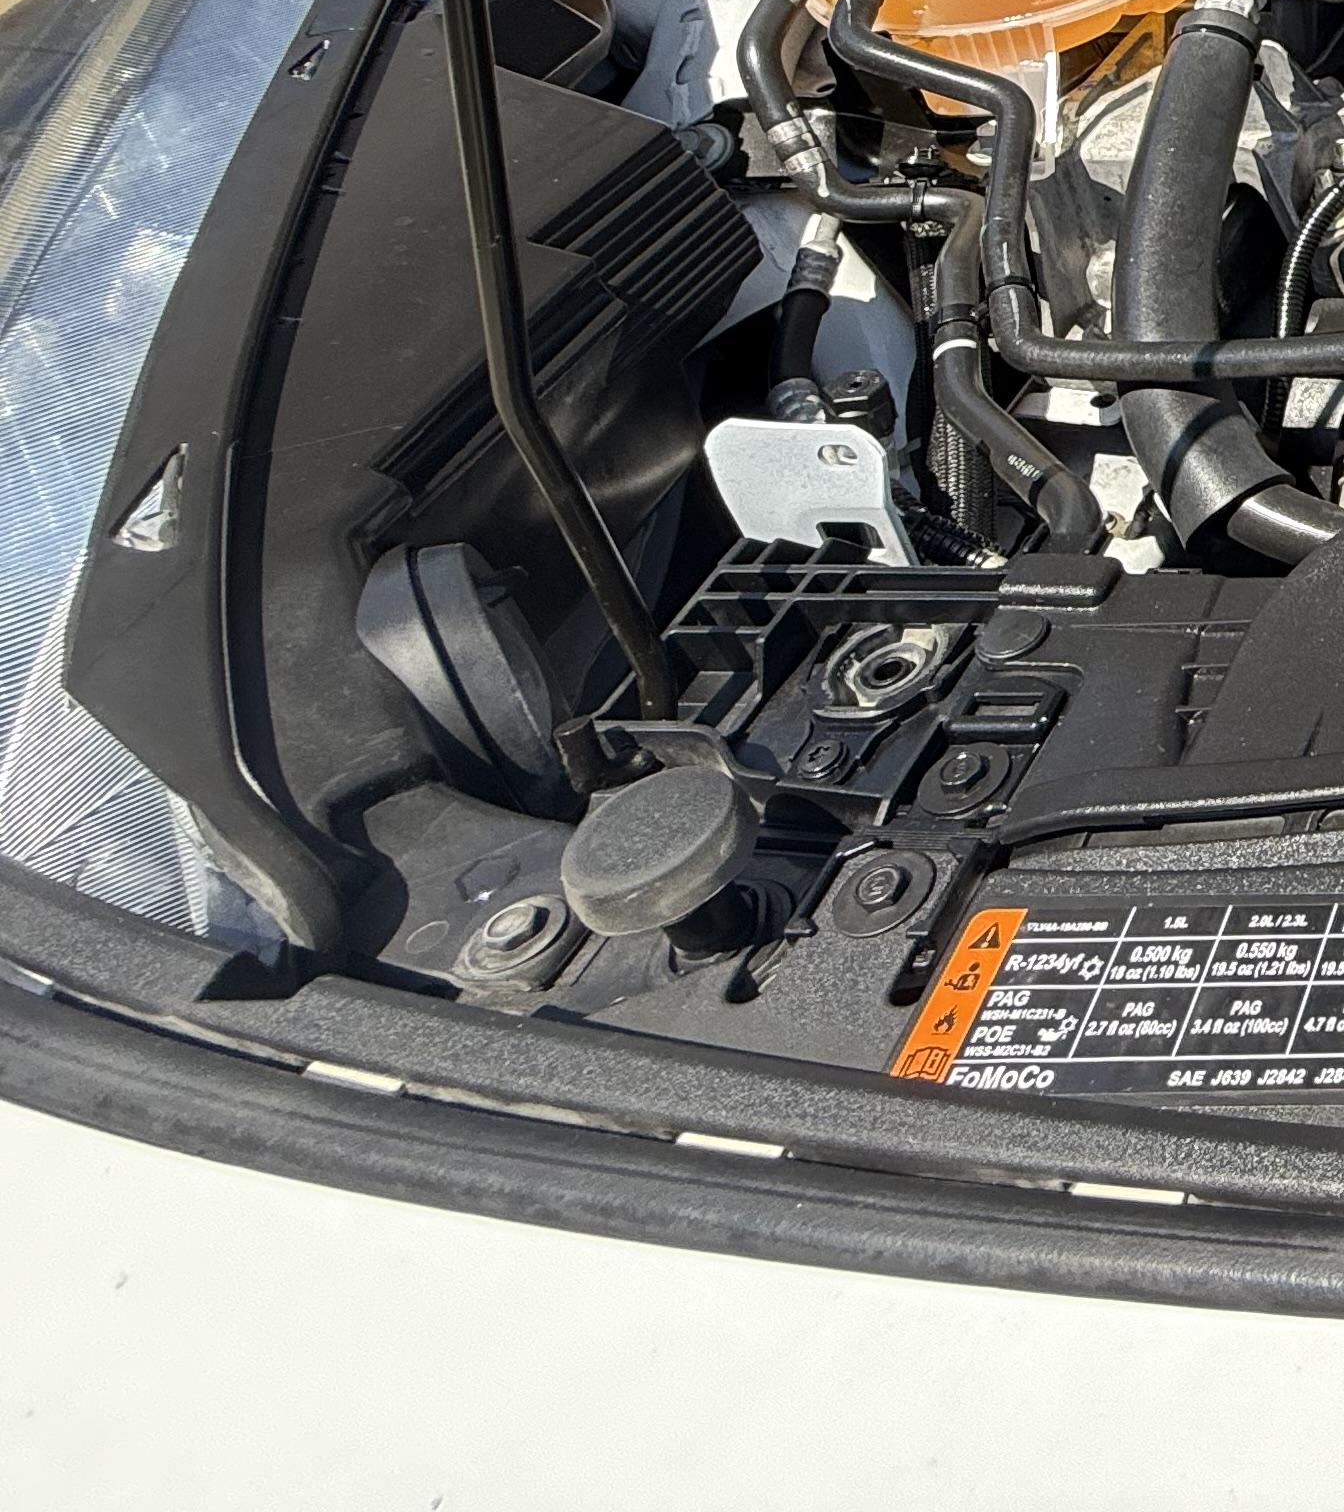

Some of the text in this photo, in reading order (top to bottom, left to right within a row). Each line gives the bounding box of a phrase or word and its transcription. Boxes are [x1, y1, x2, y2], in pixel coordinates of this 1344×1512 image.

[1130, 946, 1193, 964] 0.500 kg
[1236, 941, 1298, 960] 0.550 kg
[1005, 952, 1085, 975] R-1234yf
[1212, 961, 1311, 979] 19.5 oz (1.21 lbs)
[1320, 962, 1344, 976] 19.5
[1110, 965, 1125, 980] 18
[1125, 968, 1142, 979] oz
[1143, 965, 1174, 982] (1.10
[987, 991, 1031, 1007] PAG
[1230, 1000, 1262, 1015] PAG
[1122, 1002, 1155, 1017] PAG
[1085, 1021, 1105, 1037] 2.7
[1106, 1021, 1118, 1037] fl
[1118, 1022, 1135, 1036] oz
[1191, 1018, 1288, 1037] 3.4 fl oz (100cc)
[1304, 1017, 1324, 1032] 4.7
[1325, 1017, 1336, 1032] fl
[970, 1026, 1017, 1043] POE
[947, 1065, 1055, 1089] FoMoCo
[1167, 1070, 1205, 1087] SAE
[1210, 1070, 1252, 1087] J639
[1258, 1069, 1307, 1085] J2842
